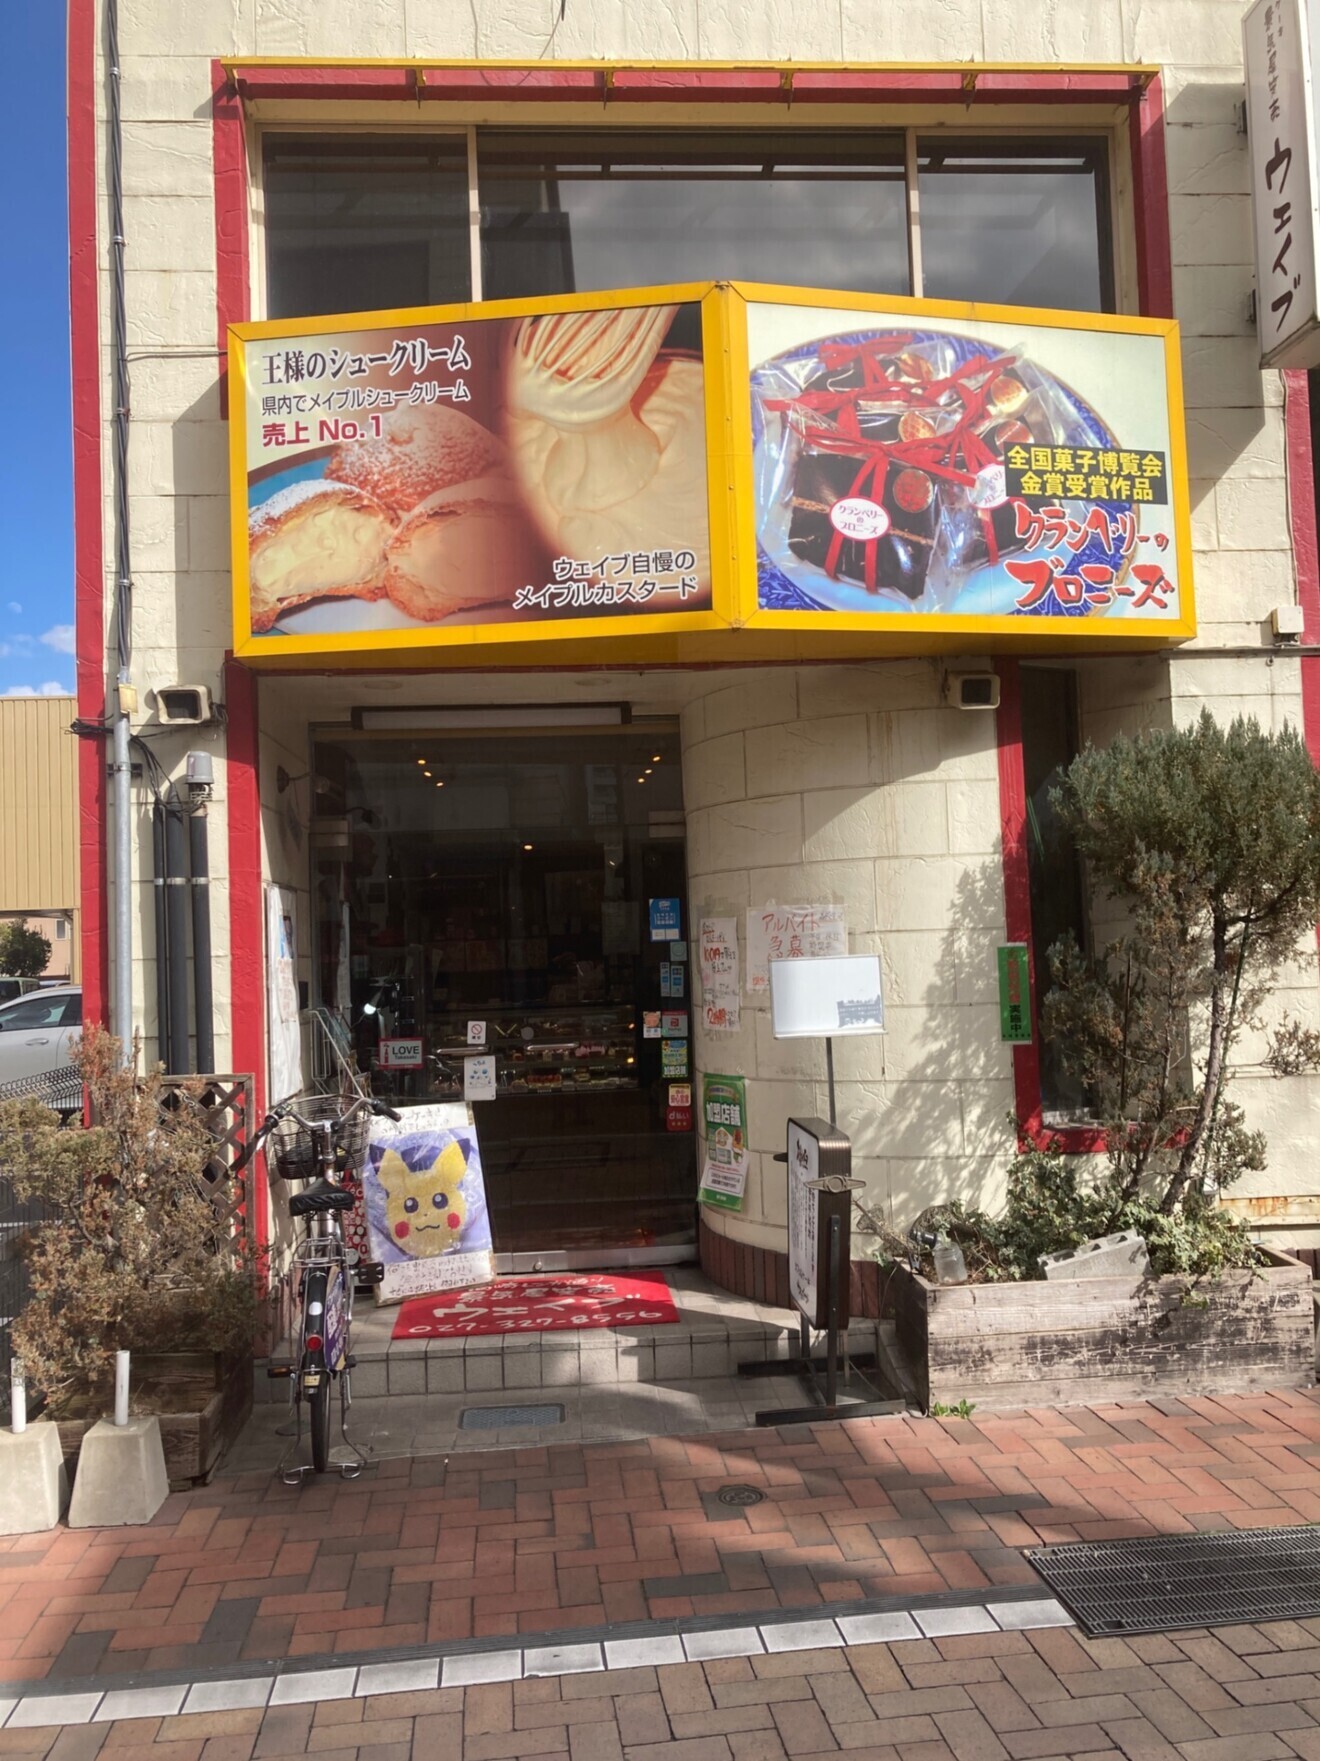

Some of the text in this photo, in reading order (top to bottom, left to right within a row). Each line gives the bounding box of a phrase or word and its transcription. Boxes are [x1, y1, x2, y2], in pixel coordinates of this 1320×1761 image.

[261, 335, 470, 386] 王様のシュークリーム
[261, 380, 470, 416] 県内でメイプルシュークリーム
[262, 415, 383, 447] 売上 No.1
[1007, 445, 1164, 478] 全国菓子博覧会
[1020, 471, 1154, 501] 金賞受賞作品
[1014, 501, 1170, 555] クランベリーの
[553, 550, 696, 581] ウェイブ自慢の
[513, 576, 698, 610] メイプルカスタード
[1003, 556, 1176, 610] ブロニーズ
[762, 913, 821, 933] アルバイト
[767, 934, 804, 959] 急募
[392, 1045, 420, 1055] LOVE
